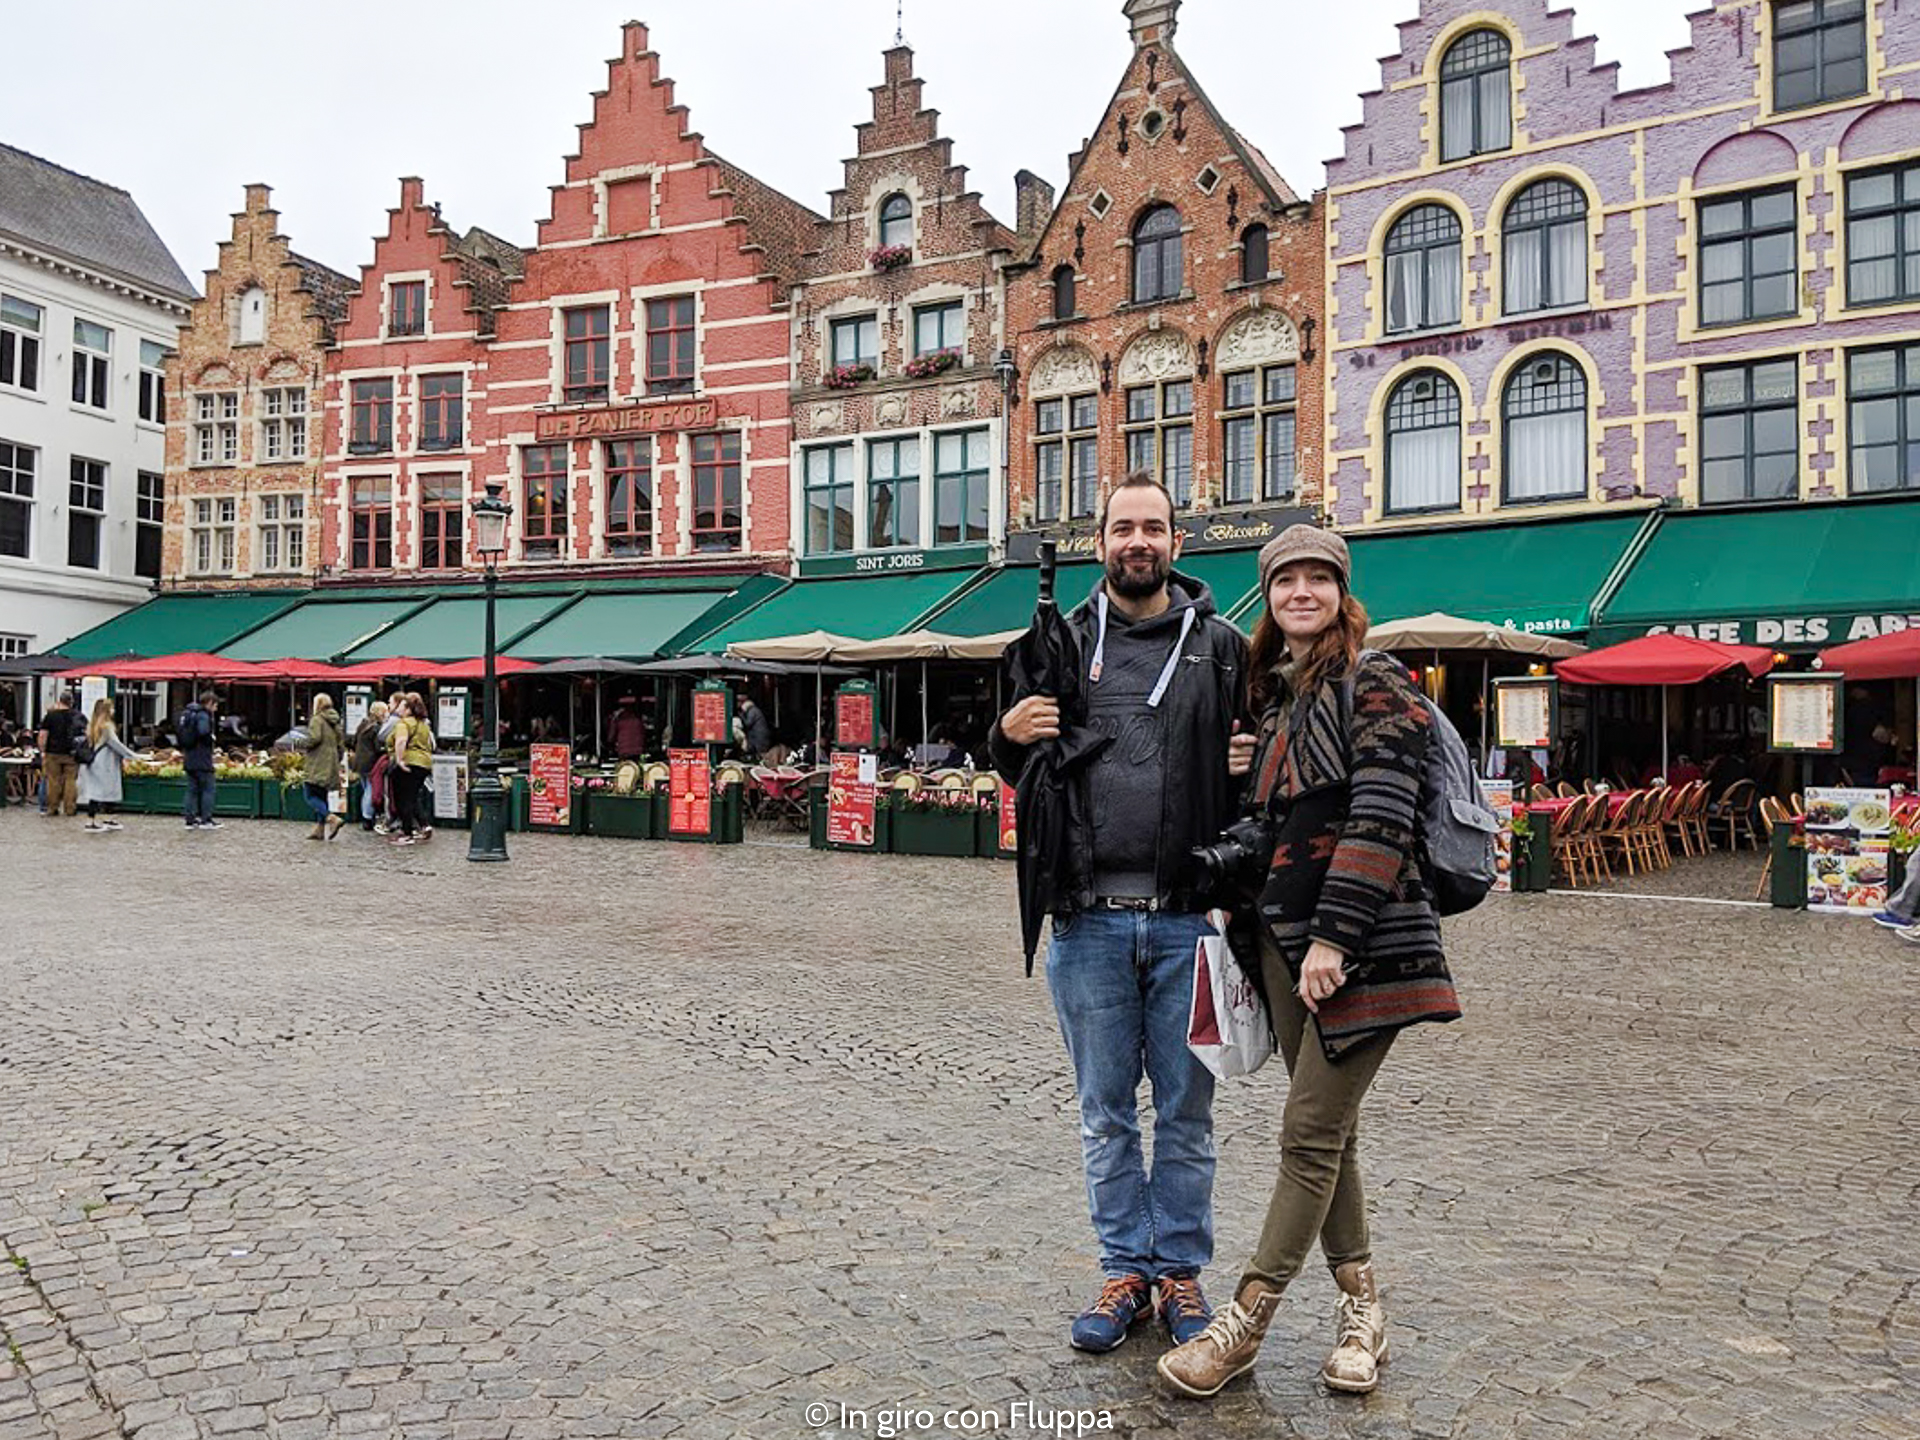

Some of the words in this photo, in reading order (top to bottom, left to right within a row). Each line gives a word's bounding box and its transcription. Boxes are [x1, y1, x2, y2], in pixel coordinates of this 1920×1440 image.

[541, 419, 570, 436] LE
[575, 409, 653, 434] PANIER
[1203, 522, 1275, 541] Brasserie
[856, 556, 885, 570] SINT
[888, 554, 924, 568] JORIS
[1524, 618, 1571, 633] pasta
[1756, 618, 1829, 643] DES
